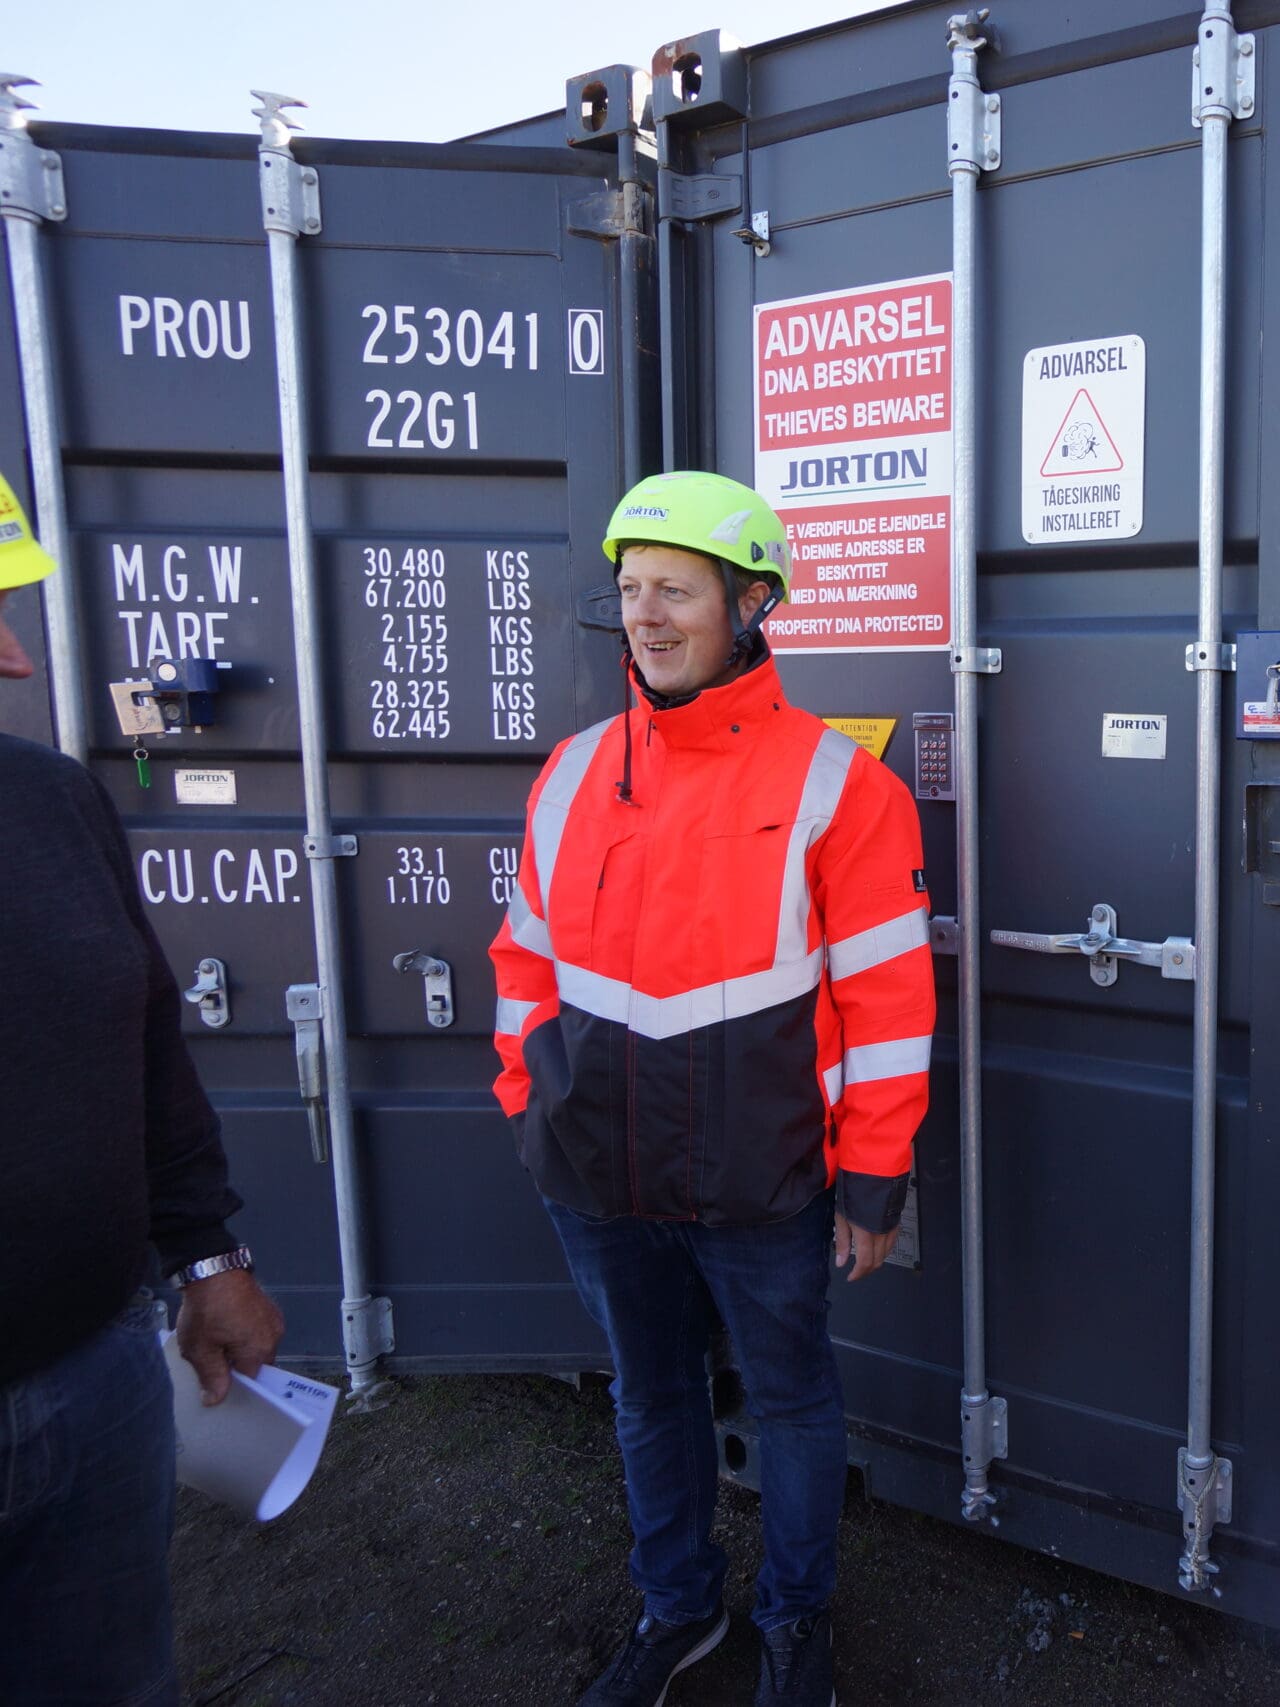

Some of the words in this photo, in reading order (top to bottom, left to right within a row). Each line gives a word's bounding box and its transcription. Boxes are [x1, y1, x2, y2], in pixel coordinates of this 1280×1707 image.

[119, 295, 251, 360] PROU
[361, 304, 538, 370] 253041
[572, 312, 599, 371] 0
[764, 295, 945, 360] ADVARSEL
[764, 365, 809, 397] DNA
[814, 345, 946, 390] BESKYTTET
[1039, 346, 1128, 380] ADVARSEL
[365, 389, 479, 450] 22G1
[764, 404, 847, 438] THIEVES
[853, 393, 945, 428] BEWARE
[780, 448, 927, 490] JORTON
[1042, 483, 1121, 507] TÅGESIKRING
[624, 507, 666, 518] JORTON
[797, 517, 877, 539] VÆRDIFULDE
[879, 512, 947, 533] EJENDELE
[1042, 510, 1121, 532] INSTALLERET
[363, 547, 445, 578] 30,480
[486, 550, 530, 580] KGS
[802, 543, 843, 561] DENNE
[845, 539, 904, 558] ADRESSE
[907, 537, 925, 554] ER
[112, 543, 259, 604] M.G.W.
[817, 562, 888, 581] BESKYTTET
[365, 579, 446, 609] 67,200
[488, 580, 532, 611] LBS
[790, 588, 816, 605] MED
[819, 587, 843, 603] DNA
[847, 583, 918, 602] MÆRKNING
[381, 613, 448, 644] 2,155
[490, 616, 533, 646] KGS
[768, 618, 833, 636] PROPERTY
[836, 617, 863, 635] DNA
[865, 615, 943, 633] PROTECTED
[383, 644, 448, 674] 4,755
[491, 646, 534, 676] LBS
[370, 680, 450, 709] 28,325
[492, 681, 535, 711] KGS
[372, 710, 450, 739] 62,445
[493, 711, 536, 740] LBS
[840, 724, 878, 732] ATTENTION
[1108, 719, 1160, 730] JORTON
[183, 774, 229, 782] JORTON
[141, 848, 301, 903] CU.CAP.
[397, 847, 444, 875] 33.1
[387, 876, 451, 904] 1,170
